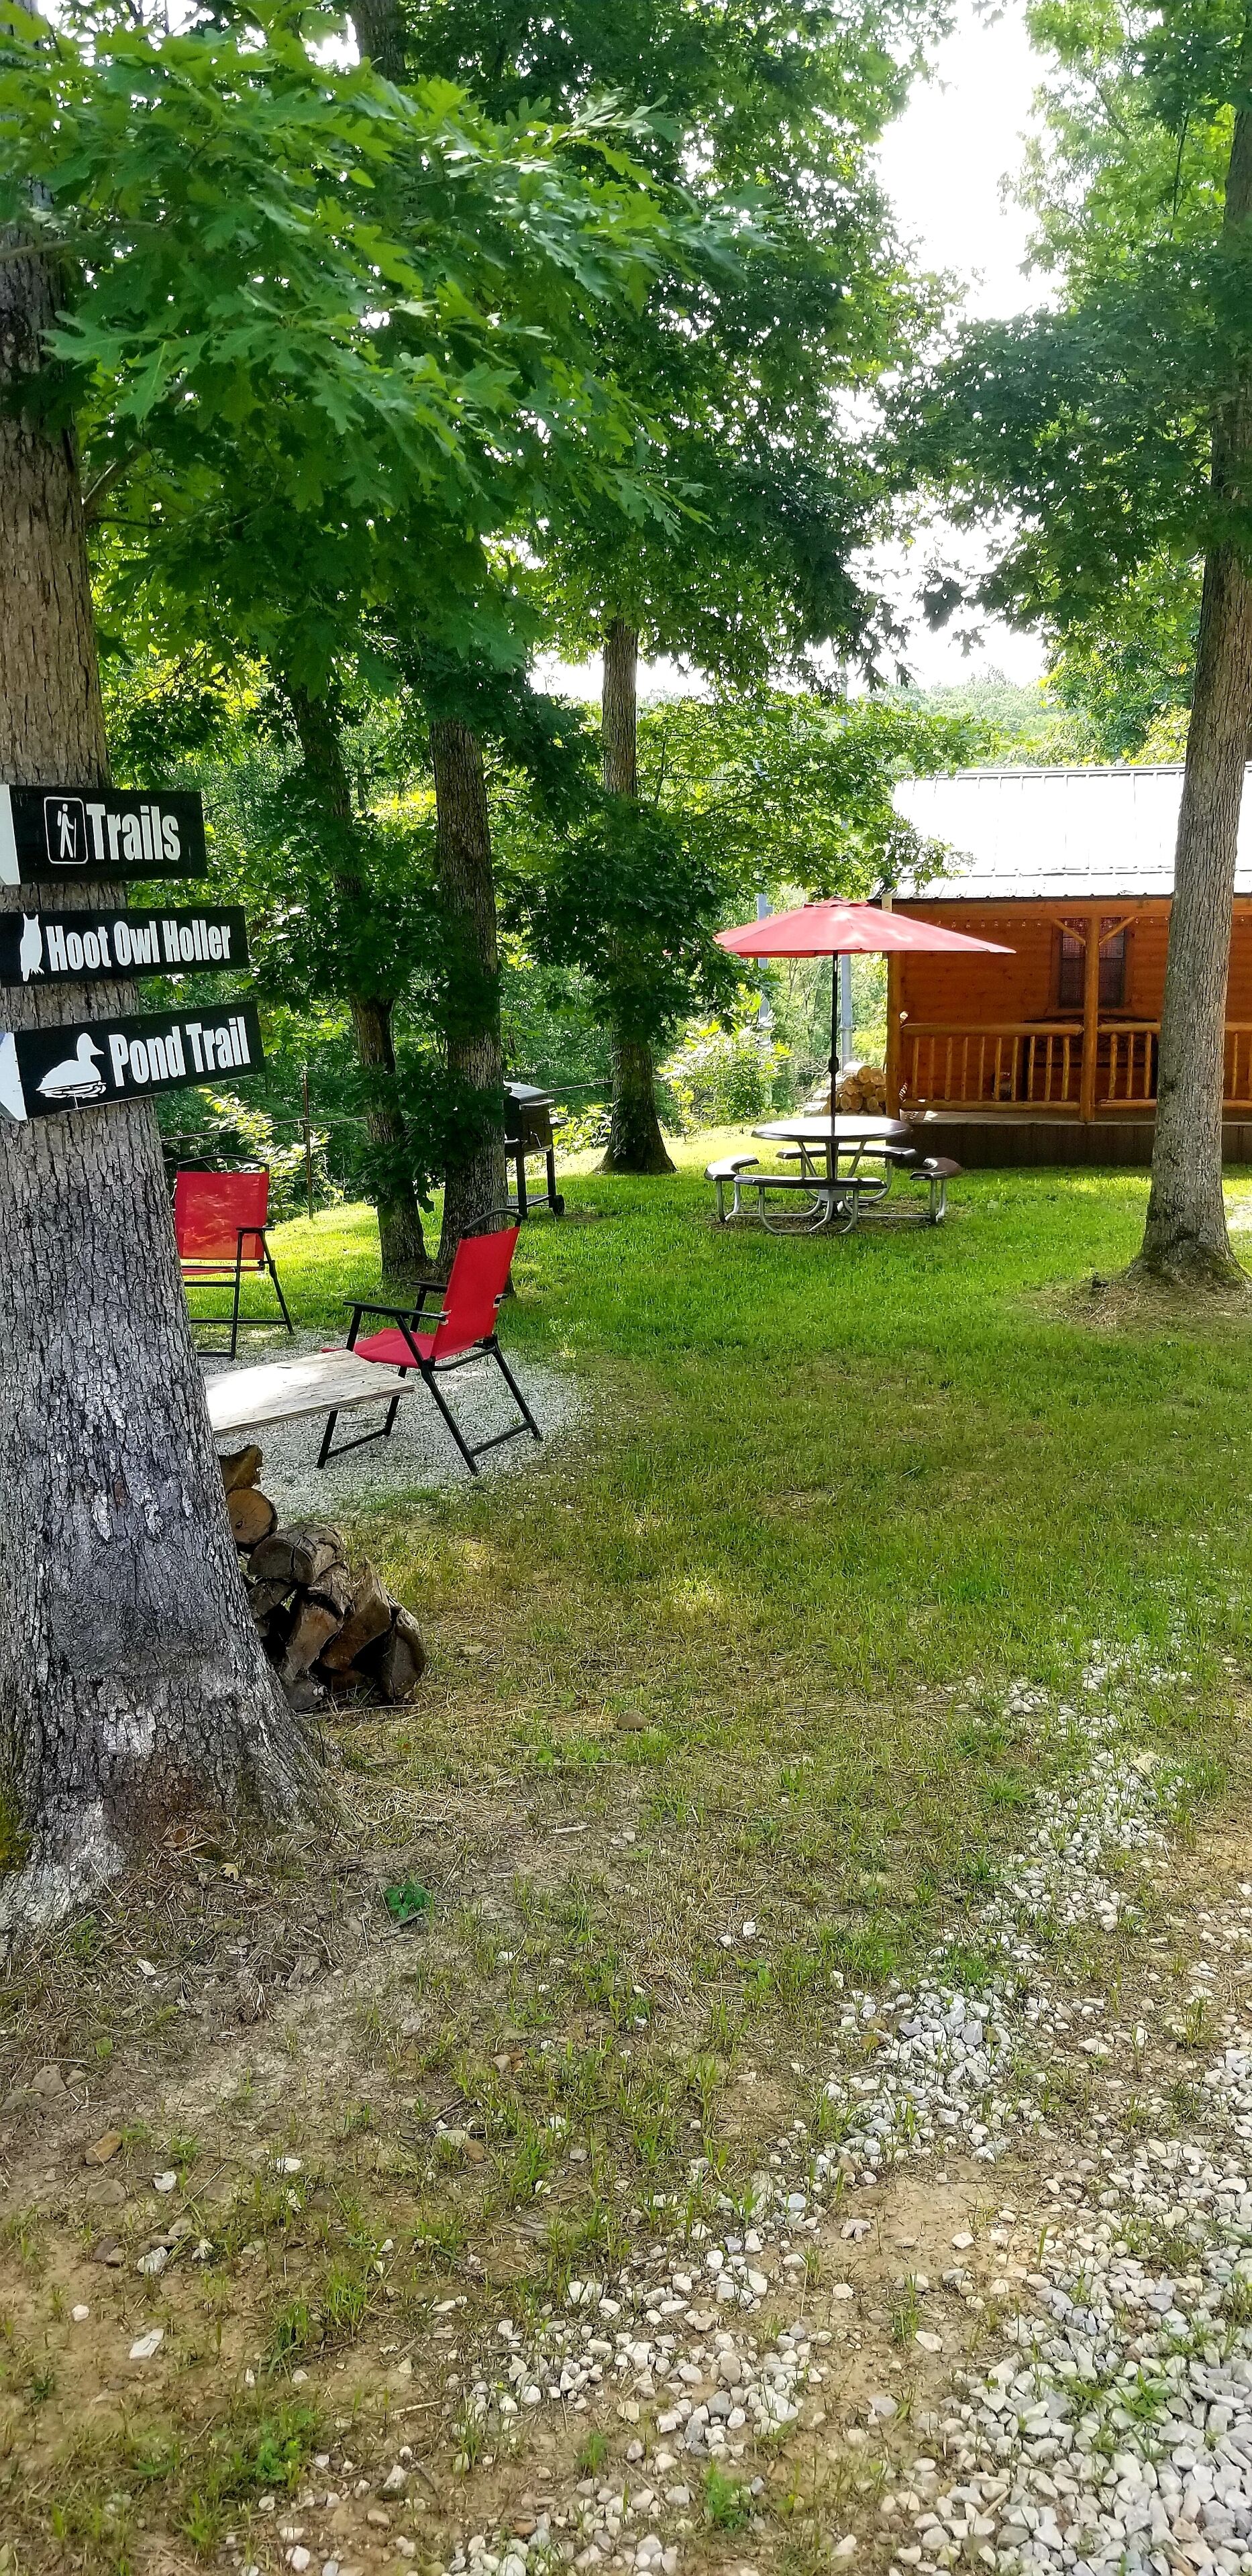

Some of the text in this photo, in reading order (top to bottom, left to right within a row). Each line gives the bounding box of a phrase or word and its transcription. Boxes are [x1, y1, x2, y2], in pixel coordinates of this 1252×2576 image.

[86, 803, 181, 861] Trails
[46, 920, 231, 971] Hoot Owl Holler
[108, 1016, 251, 1087] Pond Trail
